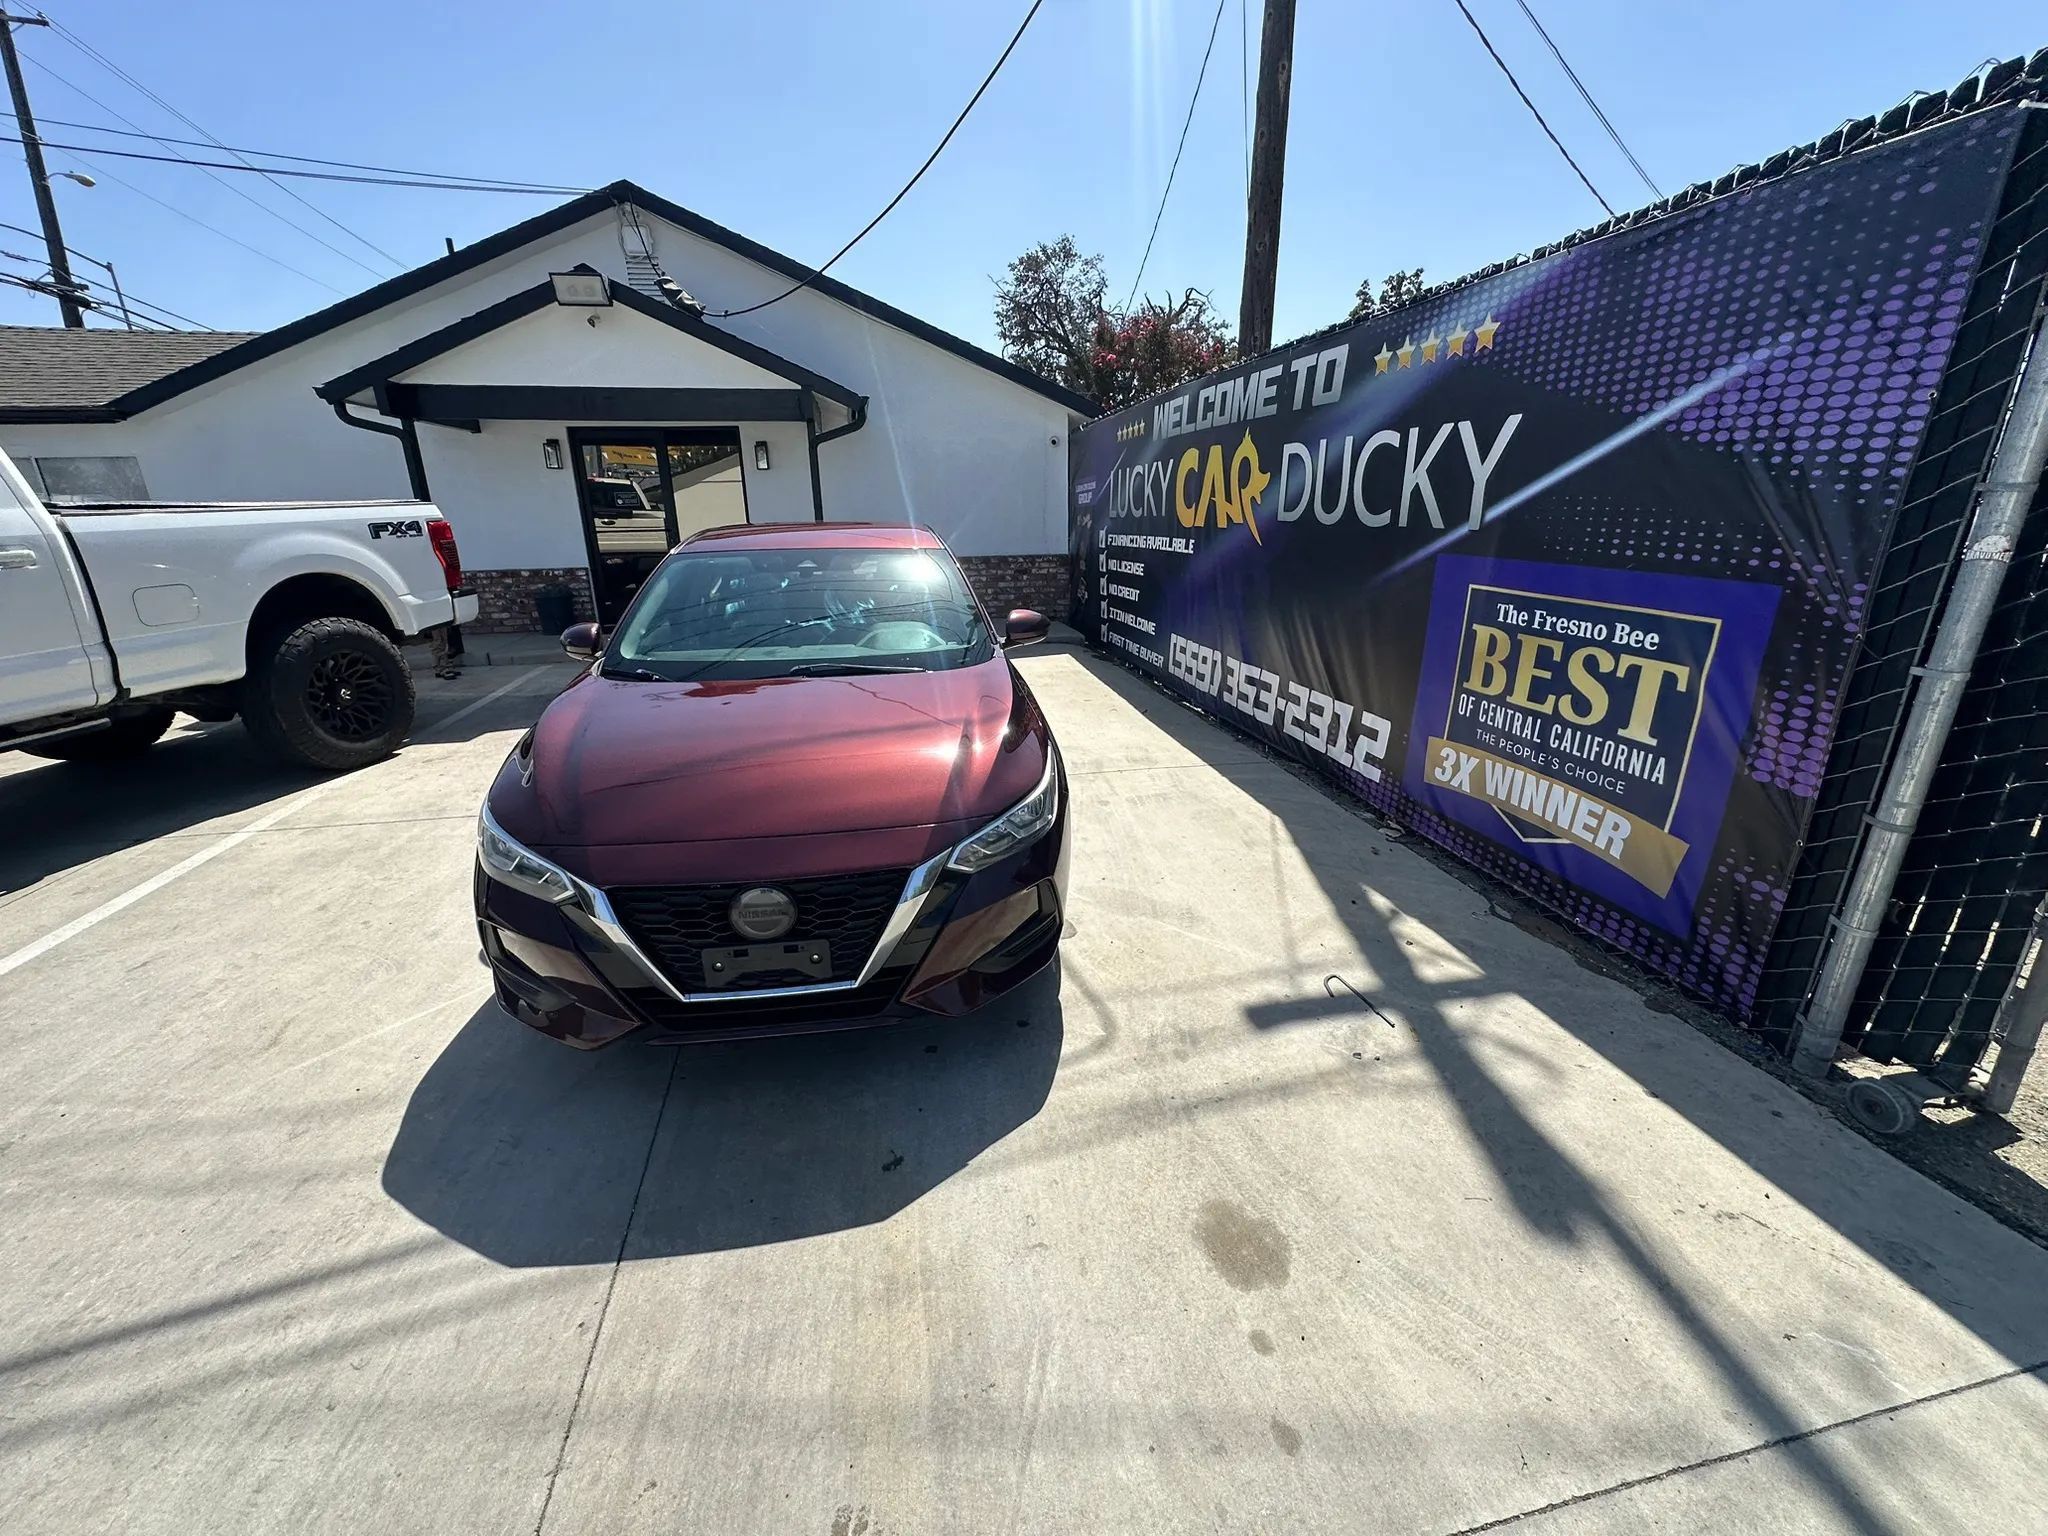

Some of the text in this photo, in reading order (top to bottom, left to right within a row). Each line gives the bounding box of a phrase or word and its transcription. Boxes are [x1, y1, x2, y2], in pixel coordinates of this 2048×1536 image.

[1153, 344, 1350, 441] WELCOME TO
[1109, 413, 1523, 546] LUCKY CAR DUCKY
[368, 520, 422, 539] FX4
[1107, 534, 1195, 554] FINANCING AVAILABLE
[1108, 559, 1145, 576] NO LICENSE
[1109, 583, 1140, 602] NO CREDIT
[1109, 607, 1157, 636] ITIN WELCOME
[1109, 631, 1164, 669] FIRST TIME BUYER
[1497, 603, 1660, 650] The Fresno Bee
[1168, 632, 1392, 783] (559) 353-2312
[1463, 623, 1690, 746] BEST
[1458, 694, 1666, 786] OF CENTRAL CALIFORNIA
[1476, 728, 1627, 795] THE PEOPLE'S CHOICE
[1434, 747, 1632, 860] 3X WINNER
